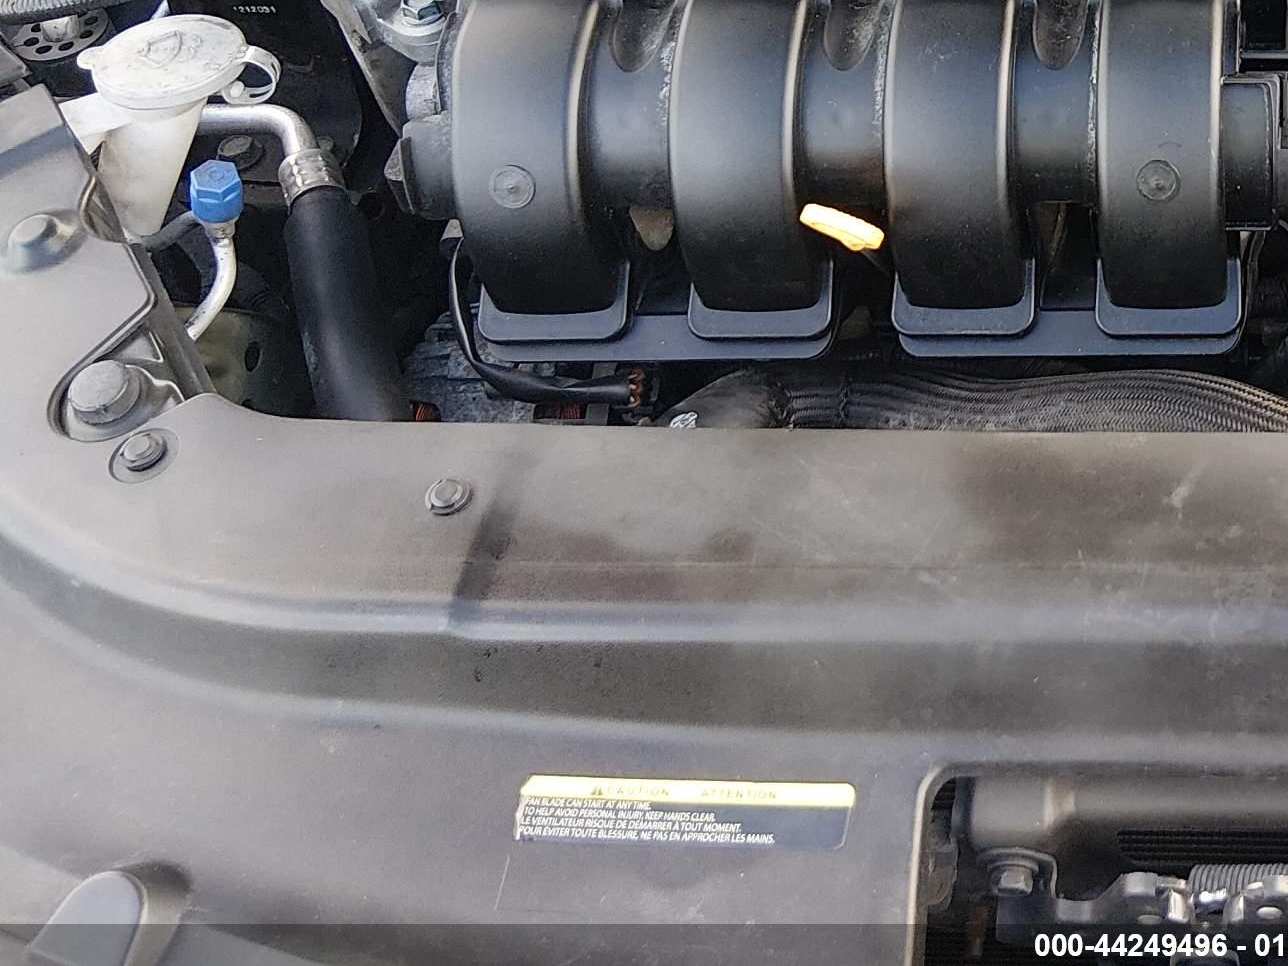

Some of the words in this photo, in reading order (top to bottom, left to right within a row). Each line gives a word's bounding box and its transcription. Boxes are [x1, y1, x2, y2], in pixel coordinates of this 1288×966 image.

[606, 786, 670, 797] CAUTION
[702, 788, 777, 800] ATTENTION
[526, 797, 541, 806] FAN
[541, 798, 565, 807] BLADE
[566, 799, 582, 808] CAN
[582, 799, 606, 808] START
[606, 800, 616, 809] AT
[616, 800, 634, 810] ANY
[524, 806, 536, 815] TO
[536, 807, 555, 816] HELP
[554, 808, 578, 817] AVOID
[578, 808, 617, 819] PERSONAL
[617, 810, 644, 821] INJURY,
[644, 811, 664, 821] KEEP
[664, 812, 690, 821] HANDS
[520, 816, 531, 824] LE
[532, 816, 584, 827] VENTILATEUR
[585, 818, 614, 829] RISQUE
[615, 819, 627, 828] DE
[628, 818, 672, 830] DÉMARRER
[681, 822, 703, 831] TOUT
[520, 825, 542, 835] POUR
[571, 827, 597, 838] TOUTE
[598, 829, 640, 840] BLESSURE,
[640, 830, 652, 839] NE
[653, 831, 668, 840] PAS
[669, 832, 681, 840] EN
[681, 832, 731, 843] APPROCHER
[731, 834, 746, 843] LES
